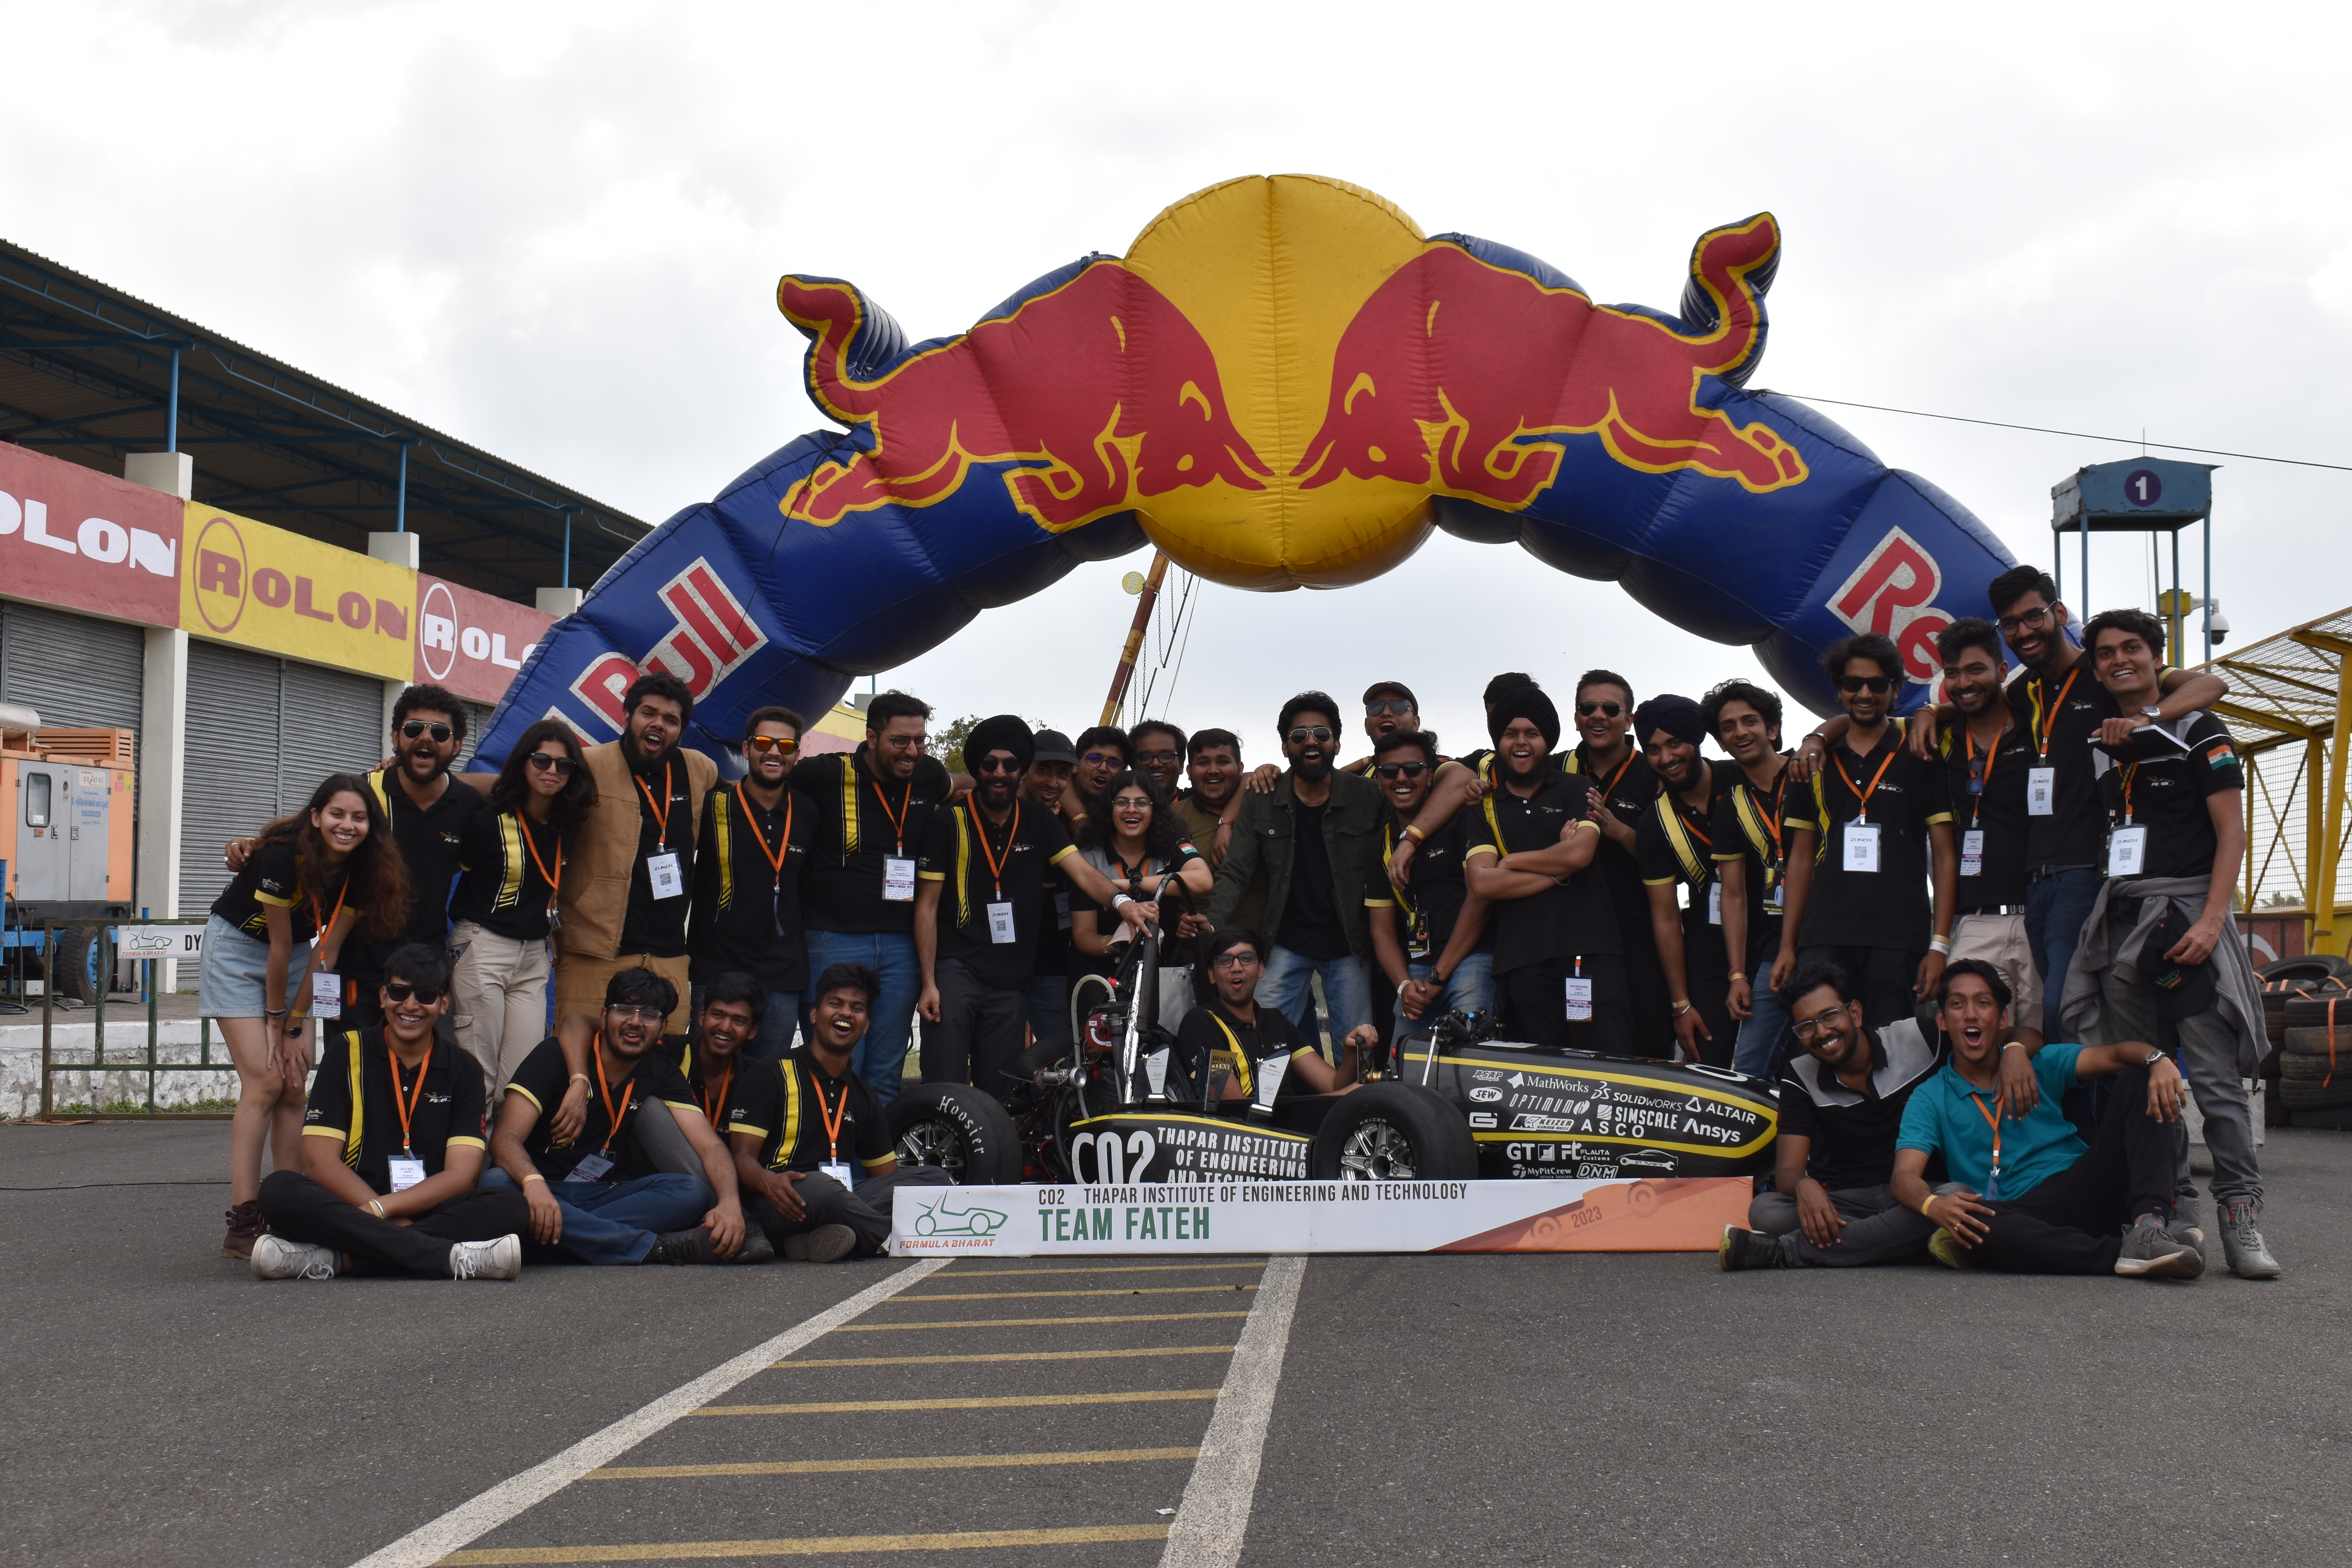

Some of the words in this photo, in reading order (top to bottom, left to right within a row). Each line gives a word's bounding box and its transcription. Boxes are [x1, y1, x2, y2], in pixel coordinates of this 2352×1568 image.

[2135, 476, 2147, 500] 1
[200, 548, 408, 641] ROLON
[1475, 1090, 1497, 1099] SEW
[1526, 1075, 1589, 1093] MathWorks
[1613, 1092, 1683, 1111] SOLIDWORKS
[935, 1095, 984, 1154] Hoosier
[1615, 1106, 1678, 1130] SIMSCALE
[1705, 1102, 1756, 1125] ALTAIR
[1682, 1118, 1741, 1143] Ansys
[1158, 1127, 1217, 1149] THAPAR
[1224, 1134, 1307, 1160] INSTITUTE
[1506, 1142, 1535, 1160] GT
[1176, 1149, 1194, 1166] OF
[1200, 1151, 1307, 1179] ENGINEERING
[1527, 1167, 1572, 1176] MyPitCrew
[1577, 1163, 1618, 1179] DNM
[1167, 1169, 1199, 1183] AND
[1084, 1188, 1137, 1204] THAPAR
[1143, 1187, 1214, 1203] INSTITUTE
[1221, 1186, 1237, 1202] OF
[1243, 1185, 1336, 1202] ENGINEERING
[1341, 1184, 1369, 1201] AND
[1375, 1183, 1467, 1200] TECHNOLOGY
[1038, 1207, 1112, 1241] TEAM
[1126, 1207, 1209, 1240] FATEH
[1571, 1206, 1602, 1228] 2023
[899, 1239, 950, 1249] FORMULA
[951, 1238, 995, 1248] BHARAT
